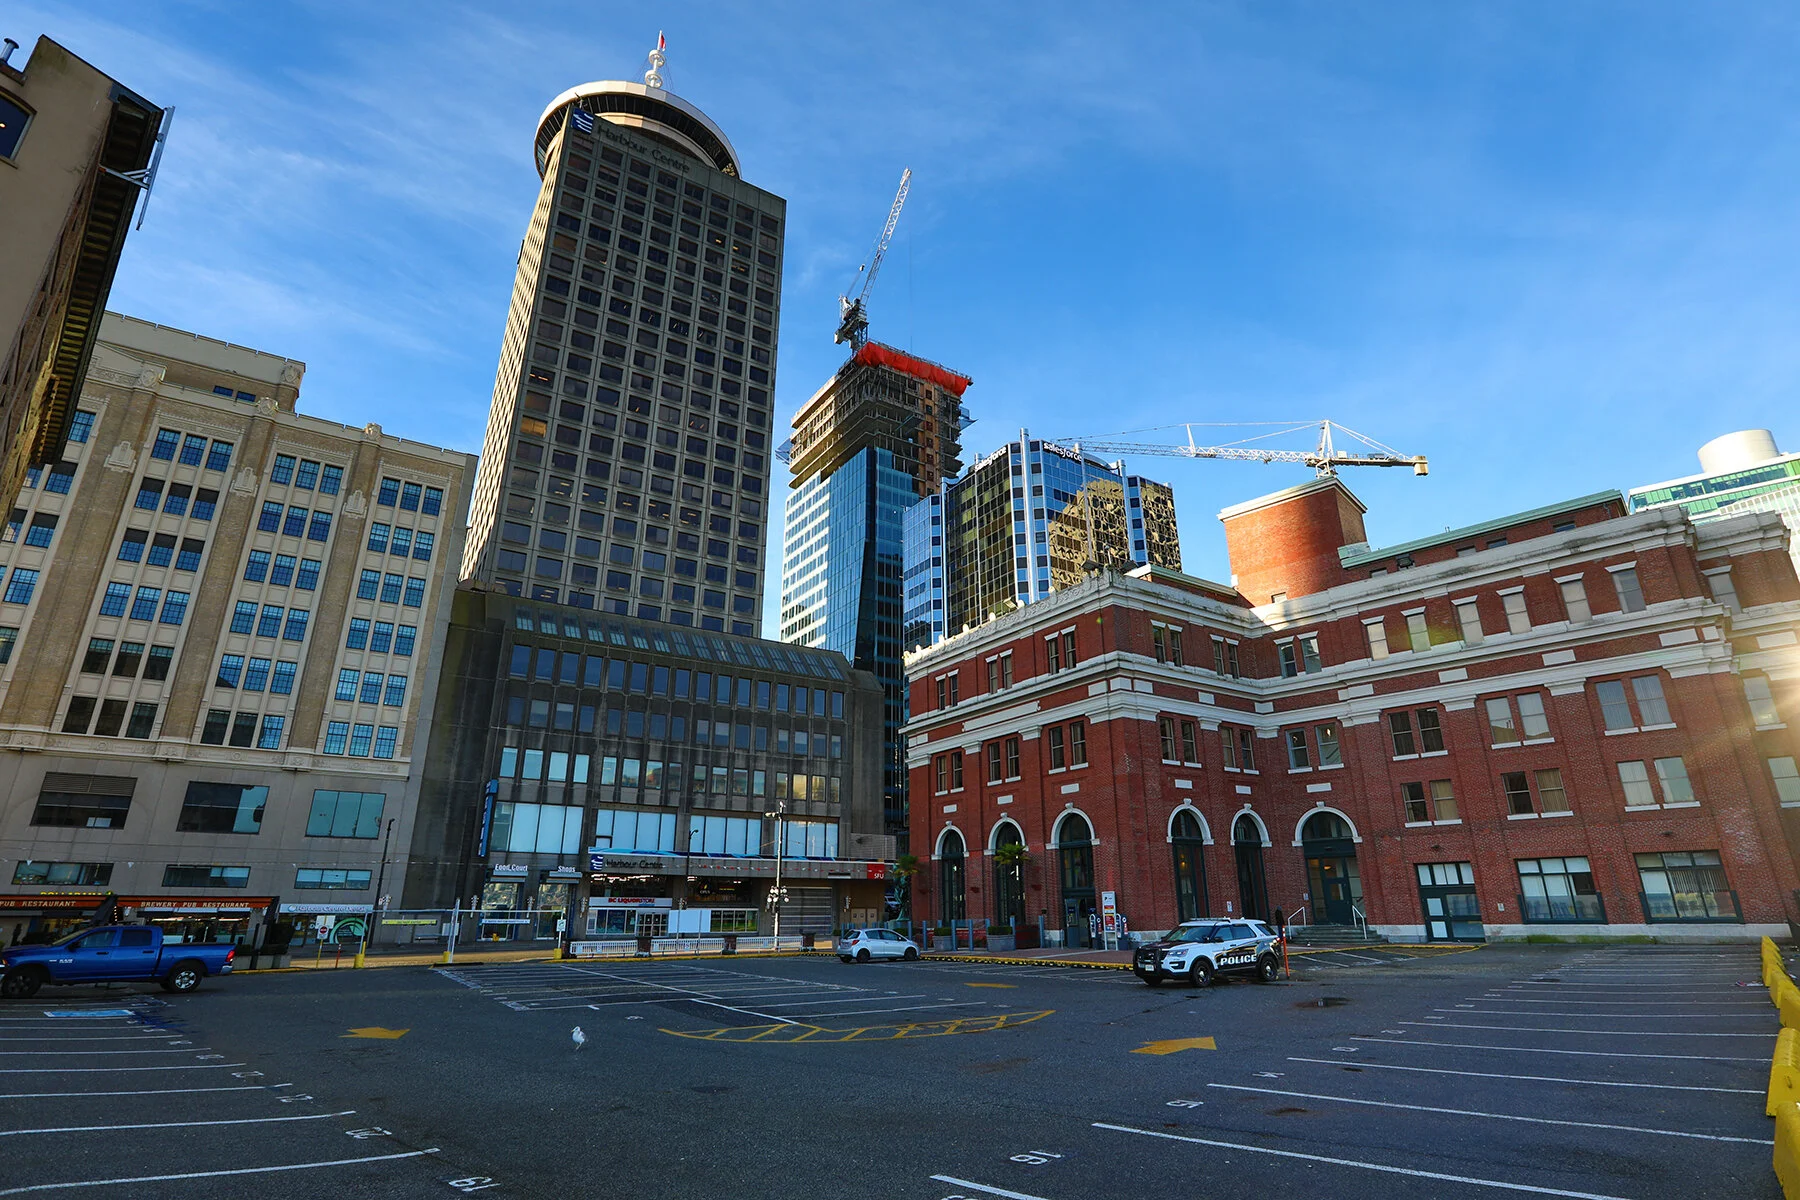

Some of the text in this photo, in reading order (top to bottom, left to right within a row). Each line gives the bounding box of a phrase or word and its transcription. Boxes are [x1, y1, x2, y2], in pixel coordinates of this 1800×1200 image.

[597, 125, 691, 174] Harbour Centre
[1043, 441, 1083, 462] salesforce
[974, 446, 1007, 472] salesforce
[494, 863, 528, 871] Food Court
[557, 865, 576, 873] Shops
[606, 858, 664, 869] Harbour Centre
[0, 900, 76, 908] PUB RESTAURANT
[1220, 954, 1258, 966] POLICE
[1009, 1150, 1063, 1164] 16
